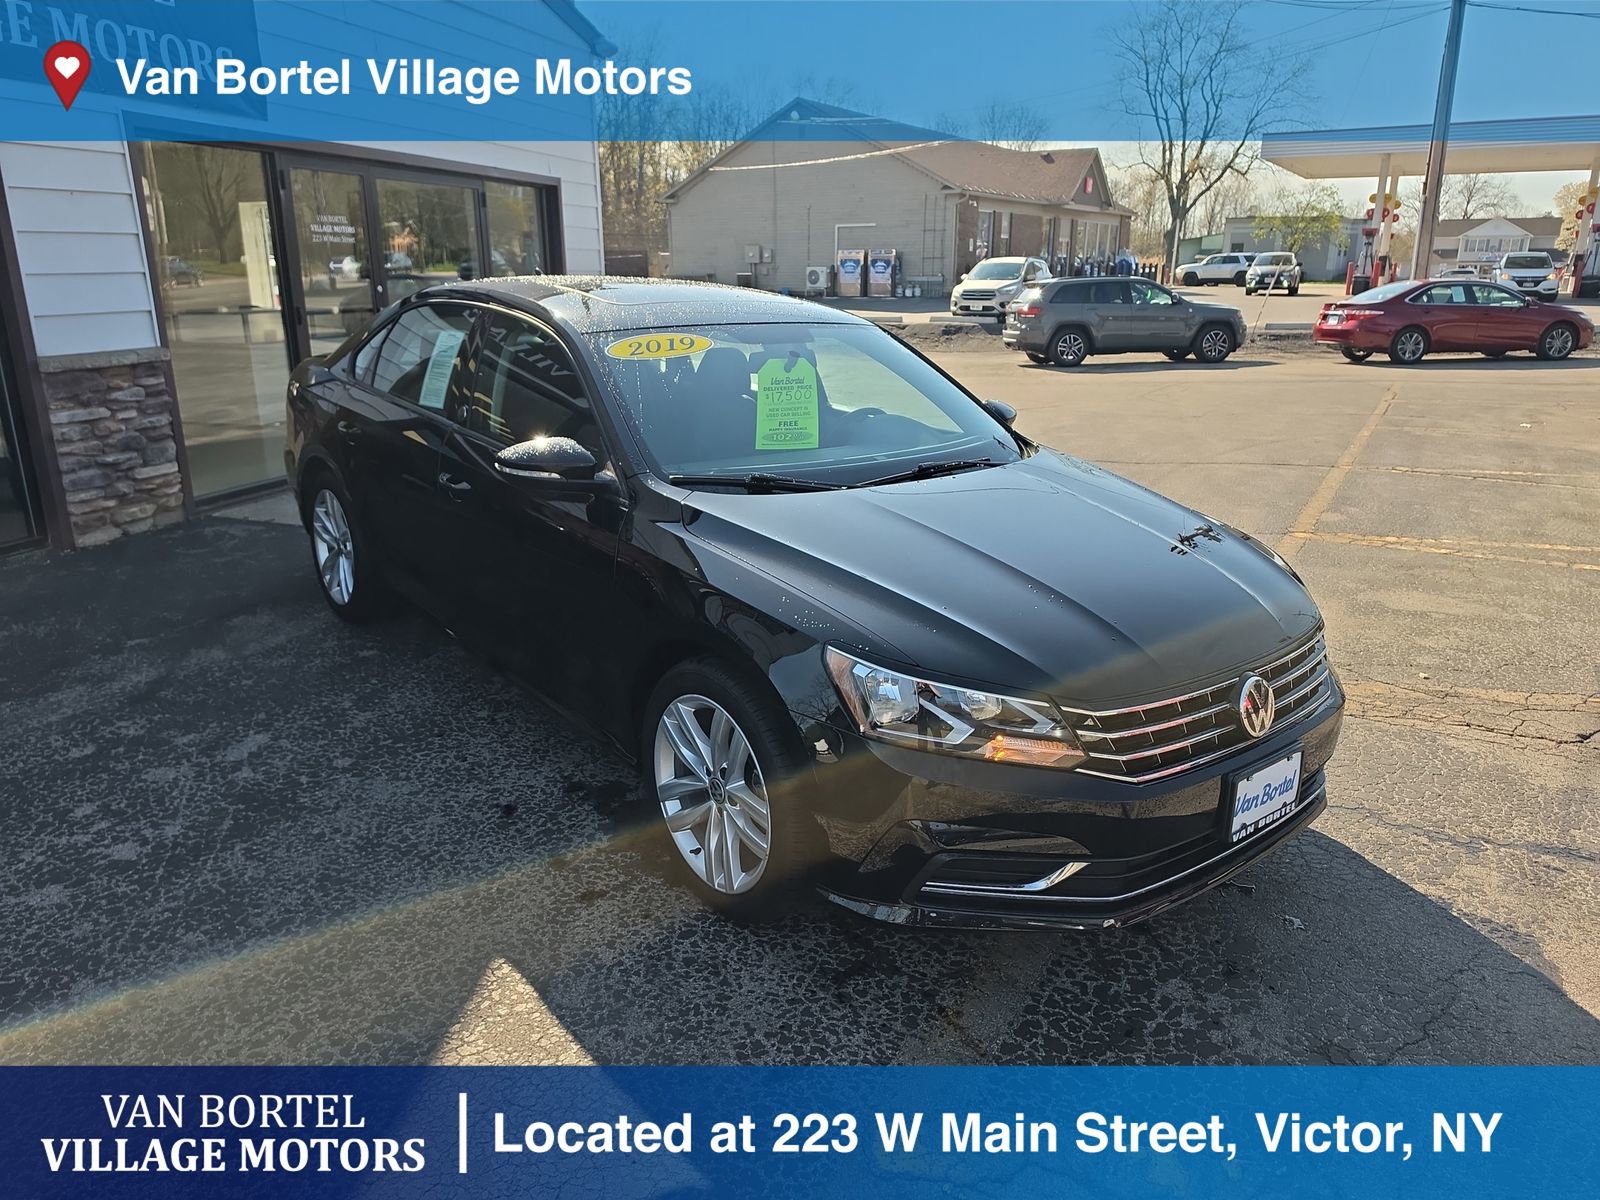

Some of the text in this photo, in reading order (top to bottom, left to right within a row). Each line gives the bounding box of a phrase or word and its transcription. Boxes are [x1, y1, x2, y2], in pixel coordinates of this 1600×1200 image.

[310, 224, 356, 234] VILLAGE MOTORS
[628, 337, 695, 356] 2019
[778, 420, 799, 428] FREE
[1234, 769, 1297, 818] Van Bortel
[1232, 802, 1296, 843] VAN BORTEL
